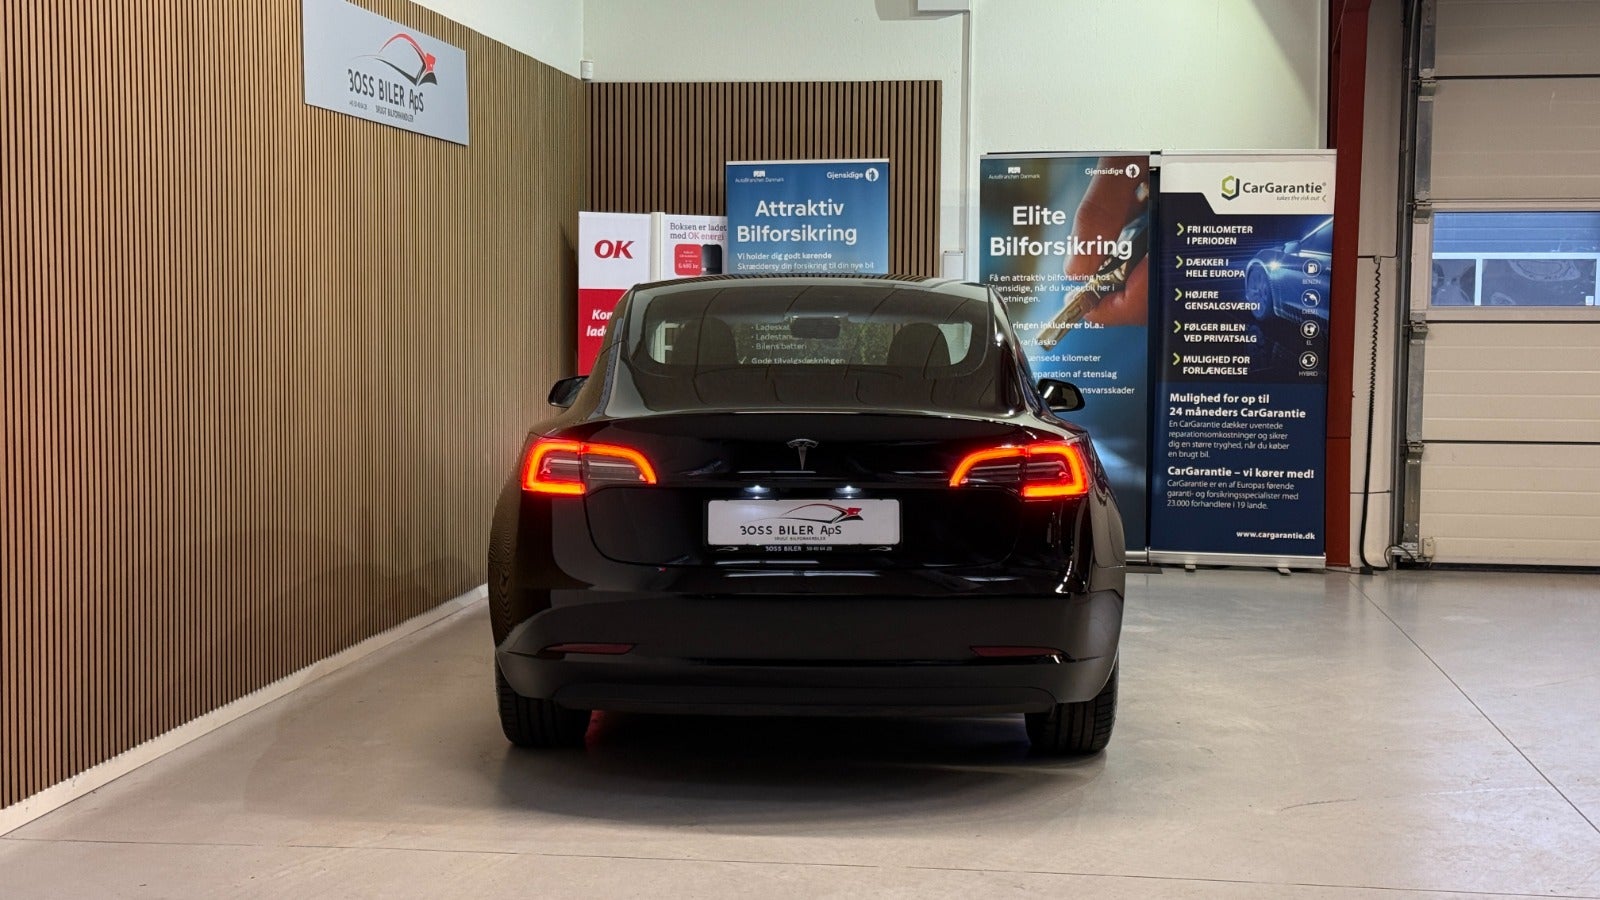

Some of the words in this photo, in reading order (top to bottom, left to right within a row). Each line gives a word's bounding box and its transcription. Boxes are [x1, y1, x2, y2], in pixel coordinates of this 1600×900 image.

[379, 79, 405, 108] BILER
[409, 88, 424, 115] ApS
[826, 171, 864, 180] Gjensidige
[1085, 167, 1124, 176] Gjensidige
[755, 198, 844, 217] Attraktiv
[1012, 205, 1066, 226] Elite
[670, 222, 697, 231] Boksen
[1187, 225, 1201, 234] FRI
[1202, 225, 1253, 234] KILOMETER
[670, 232, 687, 240] med
[688, 232, 700, 240] OK
[737, 224, 857, 245] Bilforsikring
[1192, 237, 1237, 245] PERIODEN
[594, 239, 634, 259] OK
[990, 235, 1132, 260] Bilforsikring
[746, 252, 769, 260] holder
[771, 252, 782, 261] dig
[783, 252, 801, 261] godt
[802, 251, 832, 259] kørende
[737, 262, 780, 271] Skræddersy
[781, 261, 792, 269] din
[794, 261, 828, 271] forsikring
[837, 261, 849, 269] din
[850, 262, 863, 270] nye
[865, 260, 874, 269] bil
[1186, 258, 1224, 266] DÆKKER
[989, 274, 999, 282] Få
[1012, 273, 1046, 282] attraktiv
[1047, 273, 1095, 284] bilforsikring
[1096, 273, 1110, 281] hos
[1186, 269, 1208, 277] HELE
[1209, 269, 1246, 278] EUROPA
[1034, 283, 1048, 292] når
[1003, 294, 1041, 304] etningen.
[1185, 290, 1219, 299] HØJERE
[1185, 302, 1260, 310] GENSALGSVÆRDI
[1012, 321, 1039, 330] ringen
[1040, 320, 1083, 329] inkluderer
[1184, 323, 1218, 331] FØLGER
[1220, 323, 1246, 331] BILEN
[1184, 334, 1202, 343] VED
[1203, 334, 1257, 343] PRIVATSALG
[1061, 353, 1101, 362] kilometer
[1183, 355, 1230, 364] MULIGHED
[1232, 355, 1250, 364] FOR
[1072, 370, 1081, 378] af
[1083, 370, 1118, 379] stenslag
[1183, 366, 1248, 375] FORLÆNGELSE
[1169, 393, 1221, 405] Mulighed
[1223, 393, 1239, 404] for
[1241, 396, 1256, 406] op
[1258, 394, 1270, 404] til
[1169, 407, 1182, 416] 24
[1185, 405, 1238, 417] måneders
[1240, 407, 1306, 419] CarGarantie
[1169, 420, 1178, 428] En
[1179, 420, 1220, 429] CarGarantie
[1221, 420, 1248, 429] dækker
[1249, 421, 1284, 430] uventede
[1168, 431, 1256, 441] reparationsomkostninger
[1257, 432, 1268, 441] og
[1269, 432, 1288, 440] sikrer
[1168, 440, 1180, 449] dig
[1191, 441, 1212, 449] større
[1213, 440, 1243, 450] tryghed,
[1244, 440, 1256, 449] når
[1257, 441, 1268, 449] du
[1268, 441, 1290, 450] køber
[1178, 449, 1198, 460] brugt
[1199, 450, 1210, 458] bil.
[1167, 466, 1232, 477] CarGarantie
[1242, 467, 1253, 477] vi
[1255, 467, 1284, 478] kører
[1286, 468, 1314, 479] med!
[1167, 479, 1208, 488] CarGarantie
[1217, 481, 1227, 489] en
[1229, 480, 1236, 489] af
[1236, 481, 1265, 491] Europas
[1266, 481, 1295, 490] førende
[1167, 490, 1194, 499] garanti-
[1195, 491, 1205, 500] og
[1206, 490, 1281, 500] forsikringsspecialister
[1167, 499, 1190, 507] 23.000
[1190, 499, 1231, 508] forhandlere
[1237, 501, 1245, 509] 19
[1246, 500, 1269, 510] lande.
[779, 525, 814, 535] BILER
[820, 525, 842, 537] ApS
[1236, 530, 1316, 541] www.cargarantie.dk
